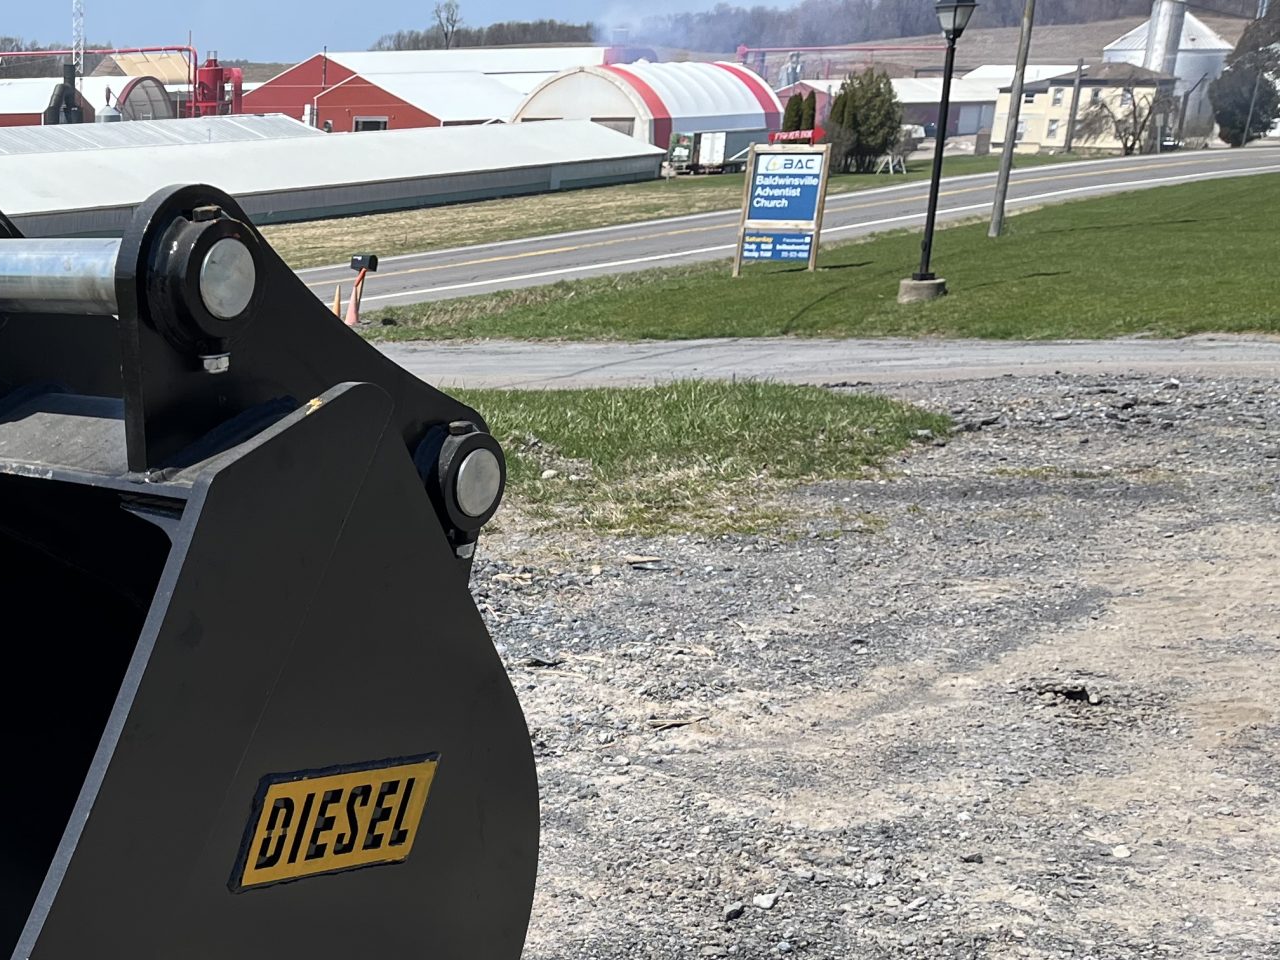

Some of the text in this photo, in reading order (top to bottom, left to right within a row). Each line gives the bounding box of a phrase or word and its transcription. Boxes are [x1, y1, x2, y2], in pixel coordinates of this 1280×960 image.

[783, 158, 815, 170] BAC
[755, 175, 819, 186] Baldwinsville
[754, 187, 801, 197] Adventist
[753, 197, 789, 208] Church
[254, 777, 416, 870] DIESEL
